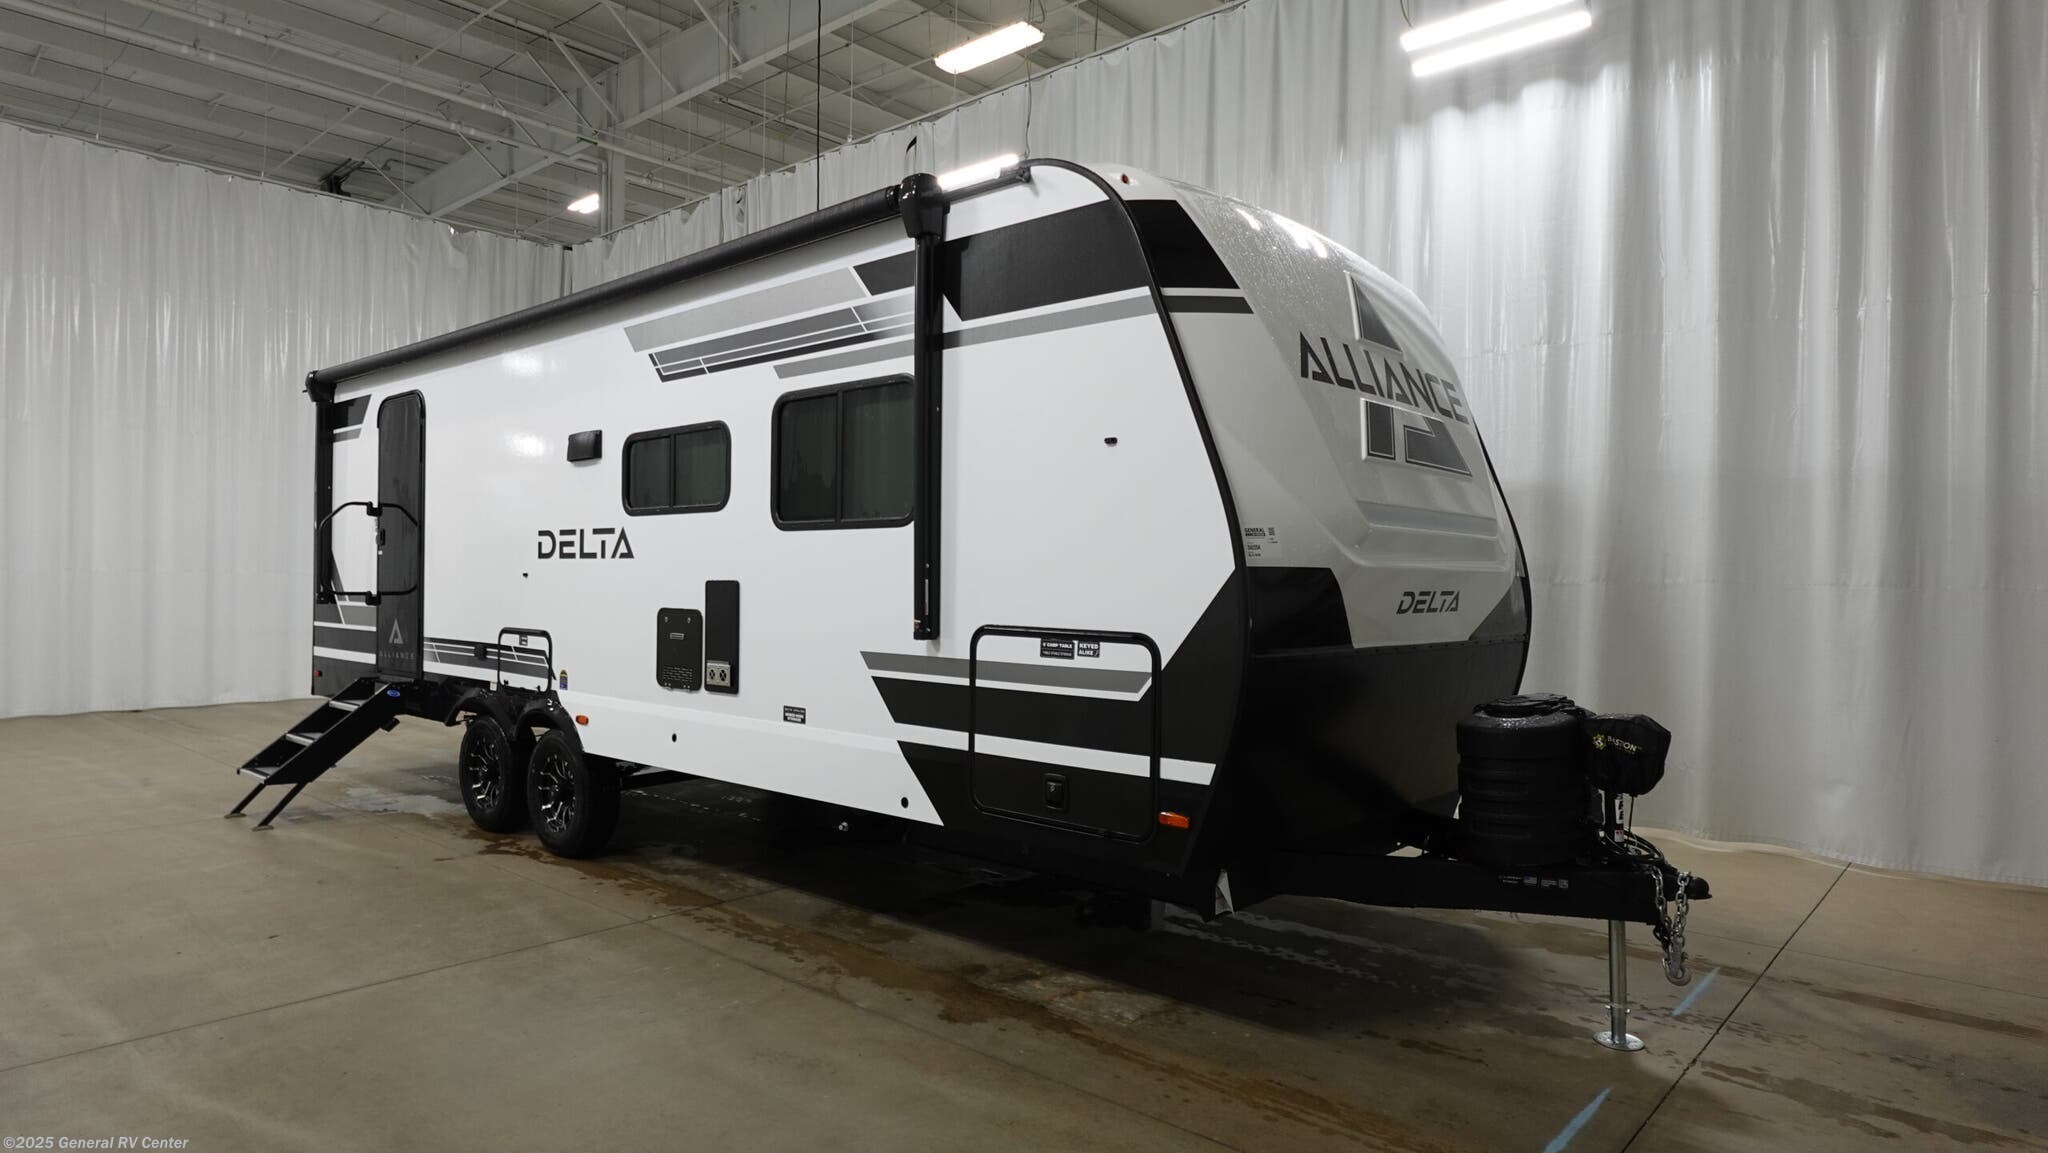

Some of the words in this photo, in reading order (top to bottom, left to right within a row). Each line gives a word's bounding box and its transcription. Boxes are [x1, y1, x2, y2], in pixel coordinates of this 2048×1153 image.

[1299, 331, 1470, 425] ALLIANCE
[537, 526, 635, 560] DELTA
[1395, 590, 1460, 615] DELTA
[1079, 642, 1099, 650] KEYED
